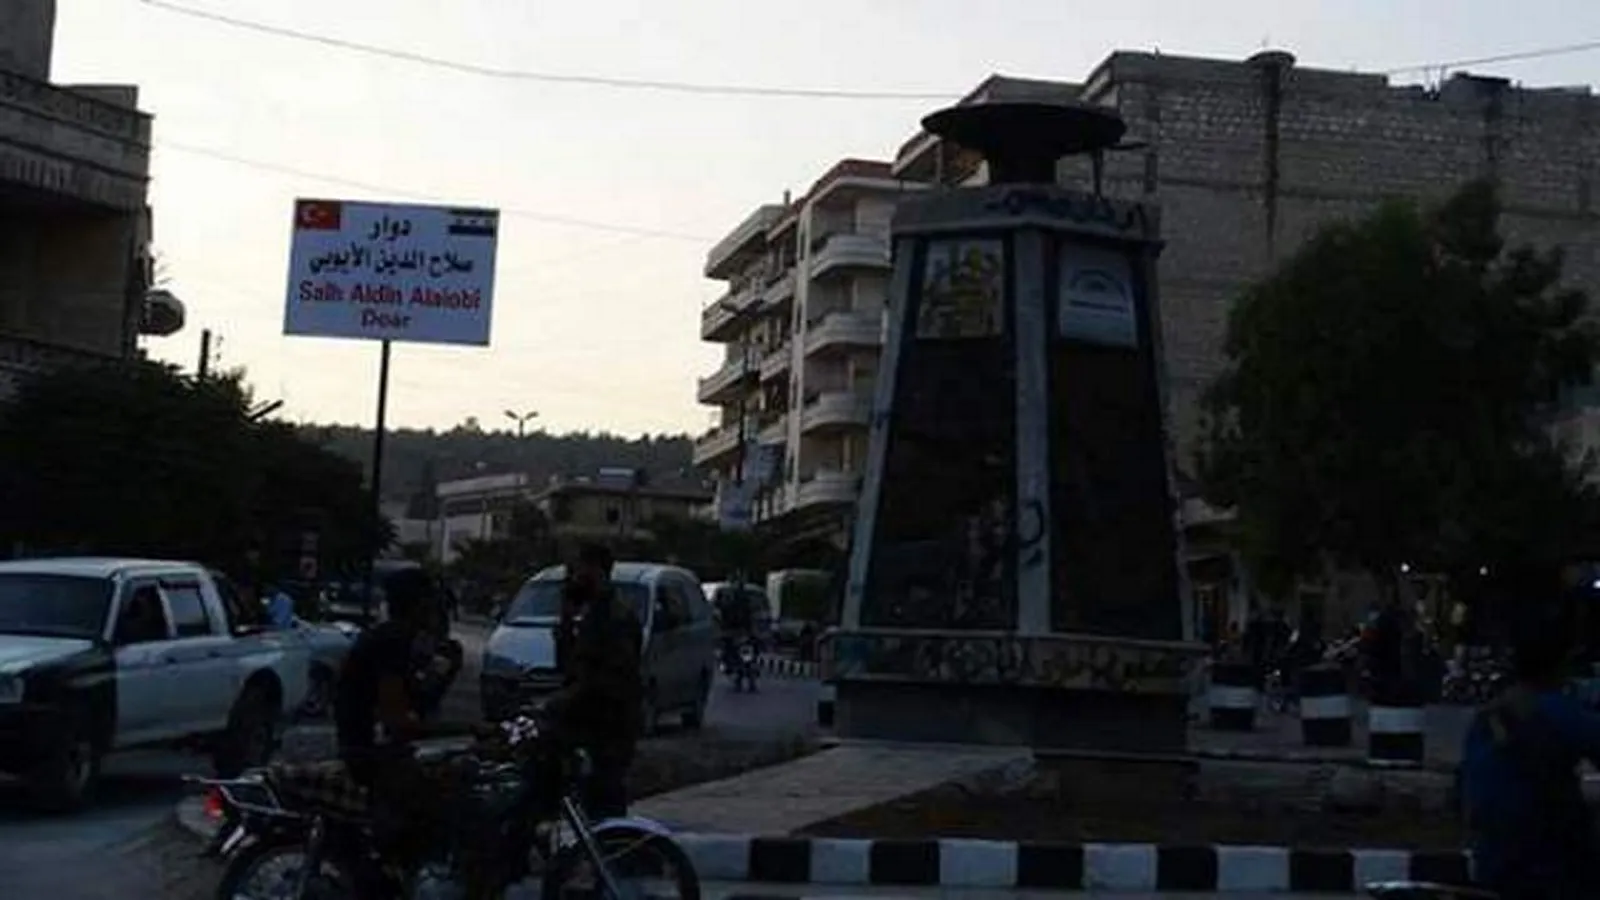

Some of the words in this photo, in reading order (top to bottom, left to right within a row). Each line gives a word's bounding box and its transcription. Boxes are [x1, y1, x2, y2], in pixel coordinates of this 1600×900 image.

[368, 215, 412, 242] دوار
[376, 248, 425, 276] الدين
[428, 250, 473, 278] صلاح
[351, 283, 402, 305] Aldin
